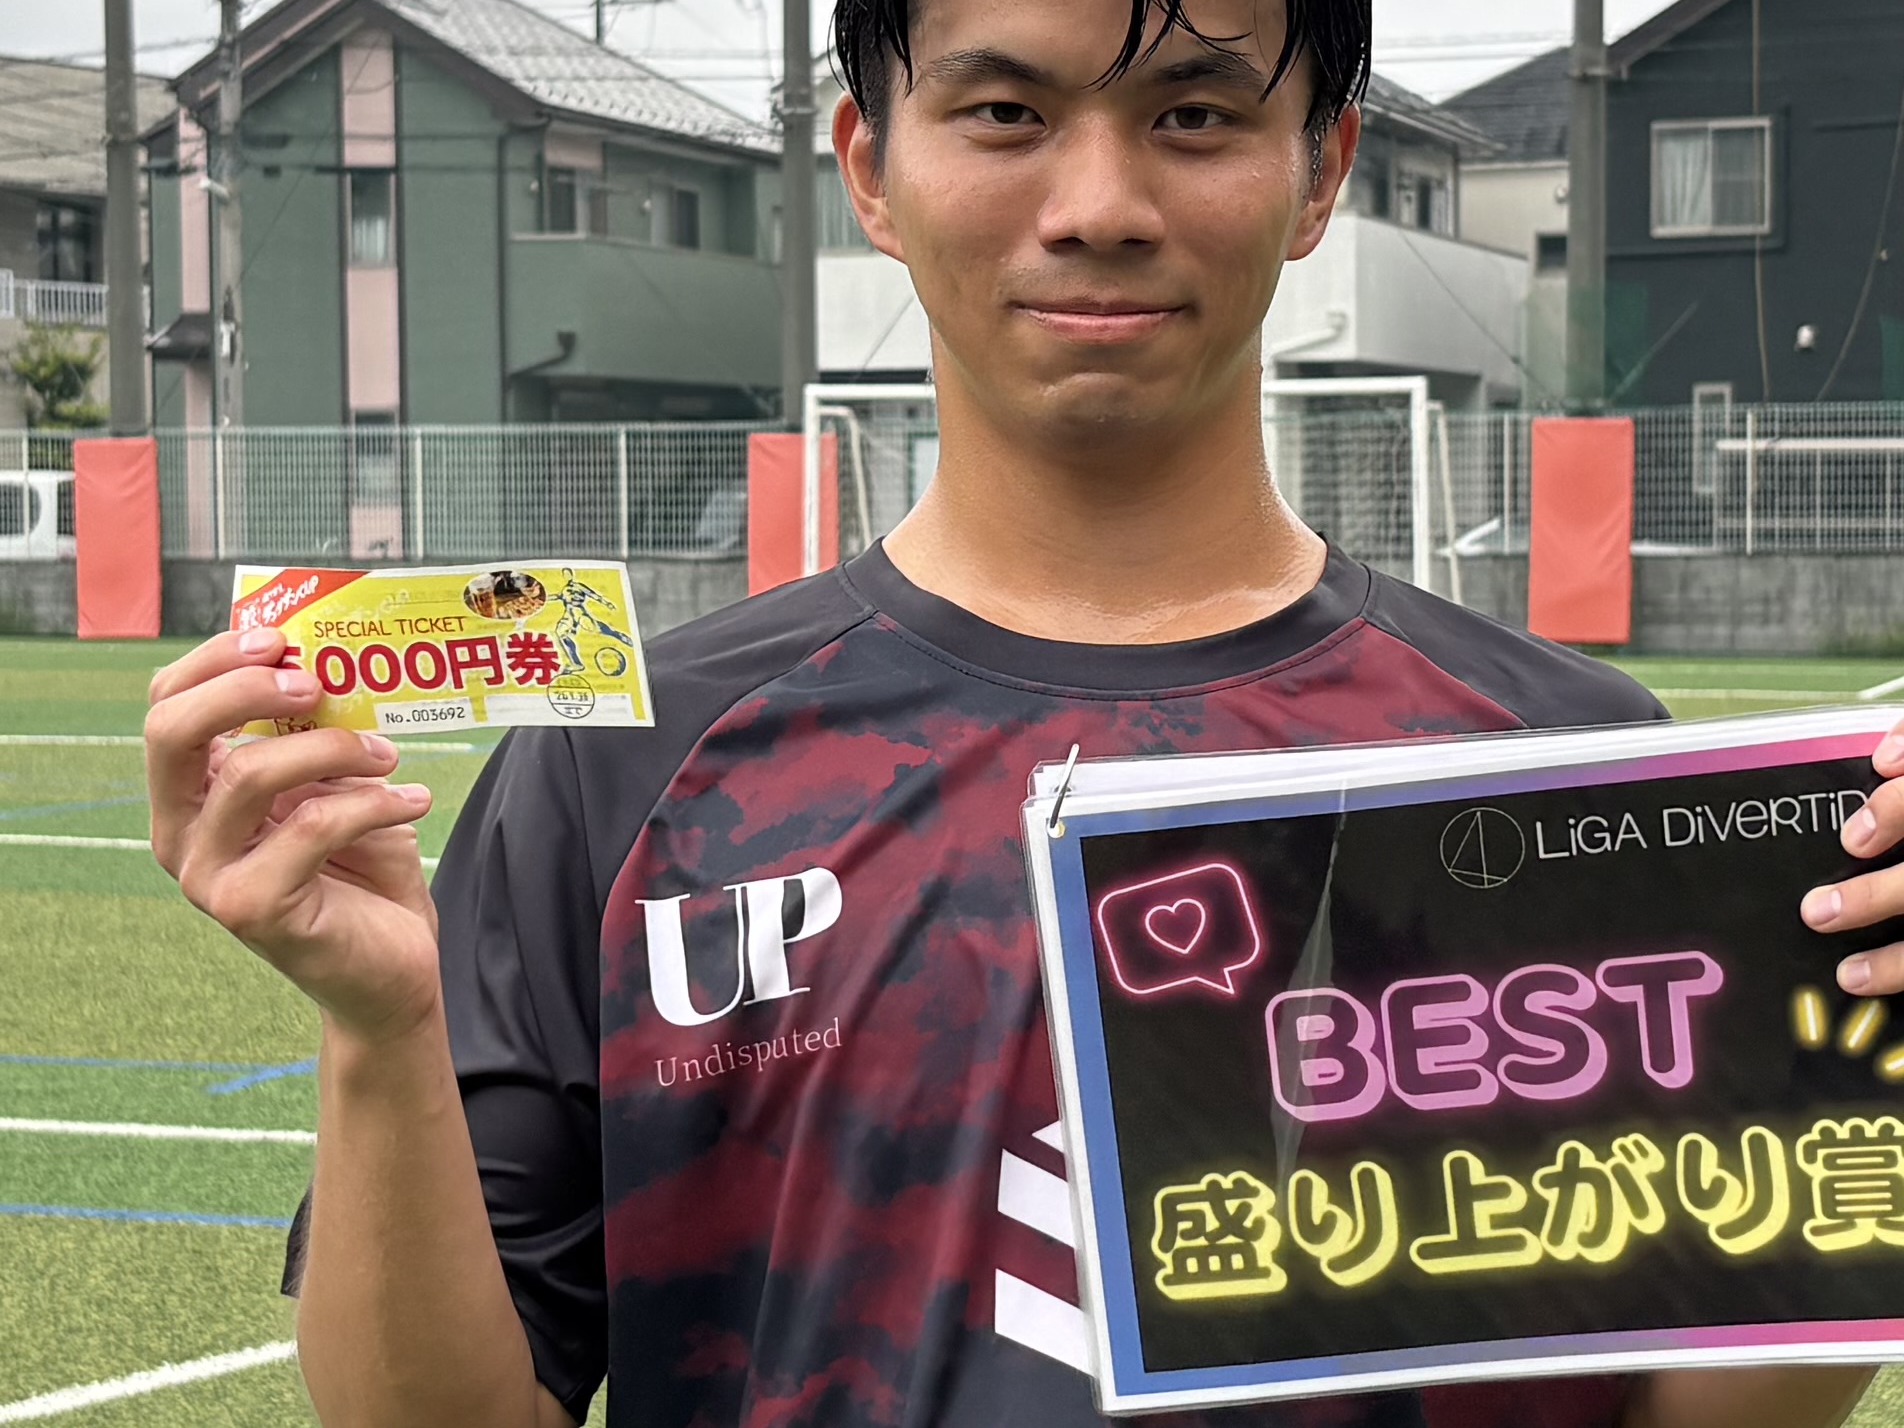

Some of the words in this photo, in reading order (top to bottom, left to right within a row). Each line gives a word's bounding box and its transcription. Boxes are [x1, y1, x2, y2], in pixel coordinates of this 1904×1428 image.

[313, 620, 391, 639] SPECIAL
[395, 615, 467, 634] TICKET
[633, 866, 844, 1028] UP
[653, 1016, 844, 1087] Undisputed
[1263, 948, 1725, 1124] BEST
